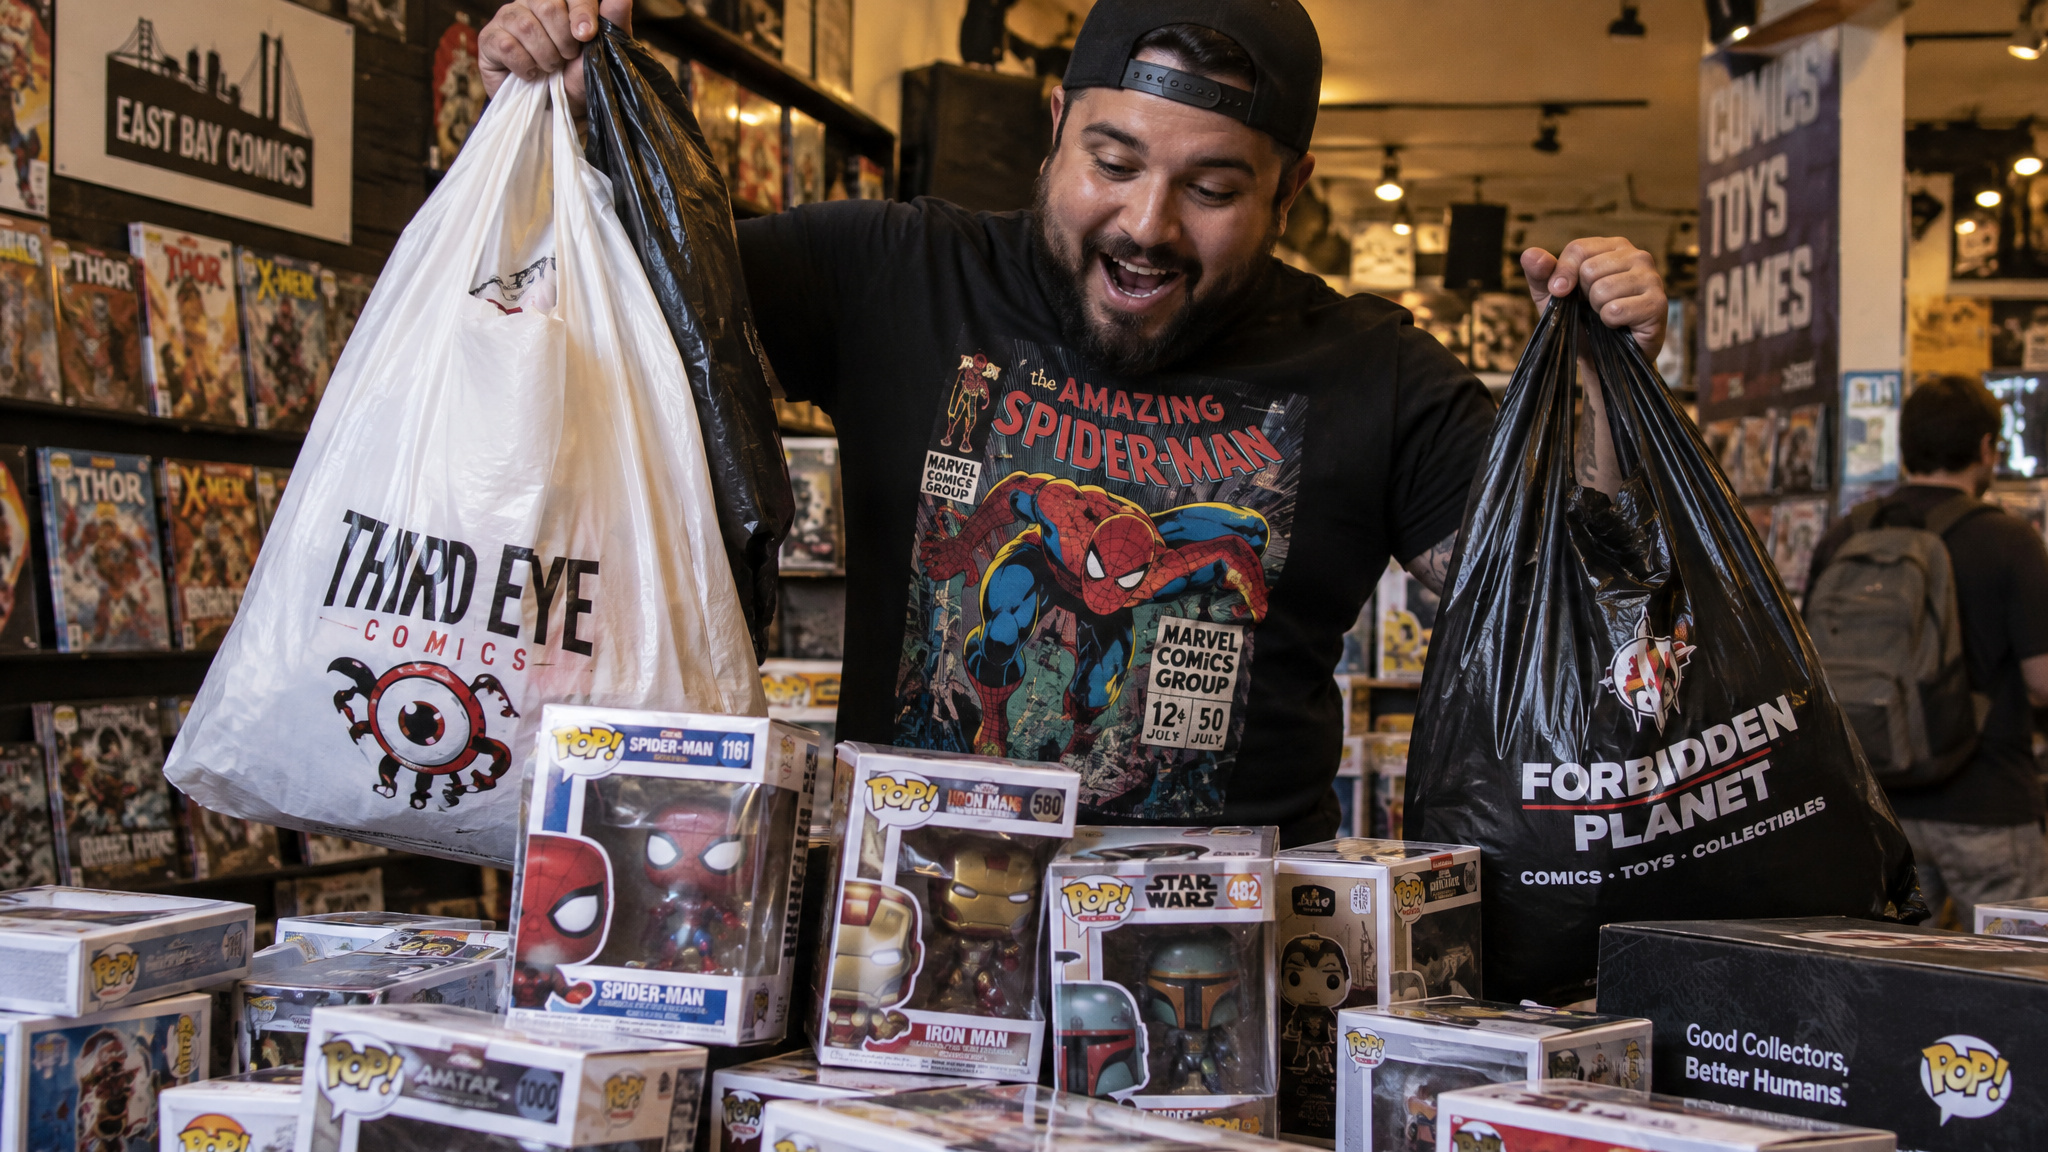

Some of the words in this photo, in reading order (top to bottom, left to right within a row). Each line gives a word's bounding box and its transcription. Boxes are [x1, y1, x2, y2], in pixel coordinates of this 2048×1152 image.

[1708, 48, 1820, 165] COMICS
[116, 96, 175, 152] EAST
[179, 114, 222, 164] BAY
[227, 129, 306, 188] COMICS
[1707, 153, 1788, 258] TOYS
[71, 251, 133, 291] THOR
[164, 244, 226, 292] THOR
[257, 257, 317, 302] X-MEN
[1705, 244, 1812, 351] GAMES
[1030, 368, 1057, 391] the
[1058, 377, 1225, 425] AMAZING
[991, 390, 1284, 487] SPIDER-MAN
[74, 467, 145, 505] THOR
[926, 469, 973, 489] COMICS
[927, 454, 977, 478] MARVEL
[180, 466, 249, 517] X-MEN
[925, 480, 969, 500] GROUP
[323, 509, 478, 625] THIRD
[487, 544, 600, 657] EYE
[364, 619, 527, 671] COMICS
[1162, 624, 1239, 653] MARVEL
[1155, 668, 1229, 695] GROUP
[1198, 707, 1224, 731] 50
[551, 725, 625, 762] POP!
[629, 736, 714, 757] SPIDER-MAN
[721, 739, 750, 761] 1161
[1521, 695, 1799, 801] FORBIDDEN
[865, 776, 939, 812] POP!
[1032, 794, 1061, 816] 580
[1574, 759, 1772, 851] PLANET
[1520, 870, 1603, 885] COMICS
[1620, 853, 1675, 879] TOYS
[1692, 796, 1827, 860] COLLECTIBLES
[1061, 881, 1134, 917] POP!
[1145, 874, 1218, 890] STAR
[1228, 880, 1258, 901] 482
[1145, 891, 1217, 909] WARS
[1394, 878, 1424, 913] POP!
[91, 951, 140, 993] POP!
[600, 981, 705, 1007] SPIDER-MAN
[925, 1024, 966, 1045] IRON
[970, 1029, 1009, 1048] MAN
[1345, 1030, 1386, 1059] POP!
[1685, 1022, 1737, 1053] Good
[1742, 1032, 1850, 1077] Collectors,
[320, 1040, 404, 1095] POP!
[519, 1080, 559, 1112] 1000
[1685, 1056, 1749, 1089] Better
[1753, 1067, 1848, 1107] Humans.
[1921, 1042, 2010, 1102] POP!
